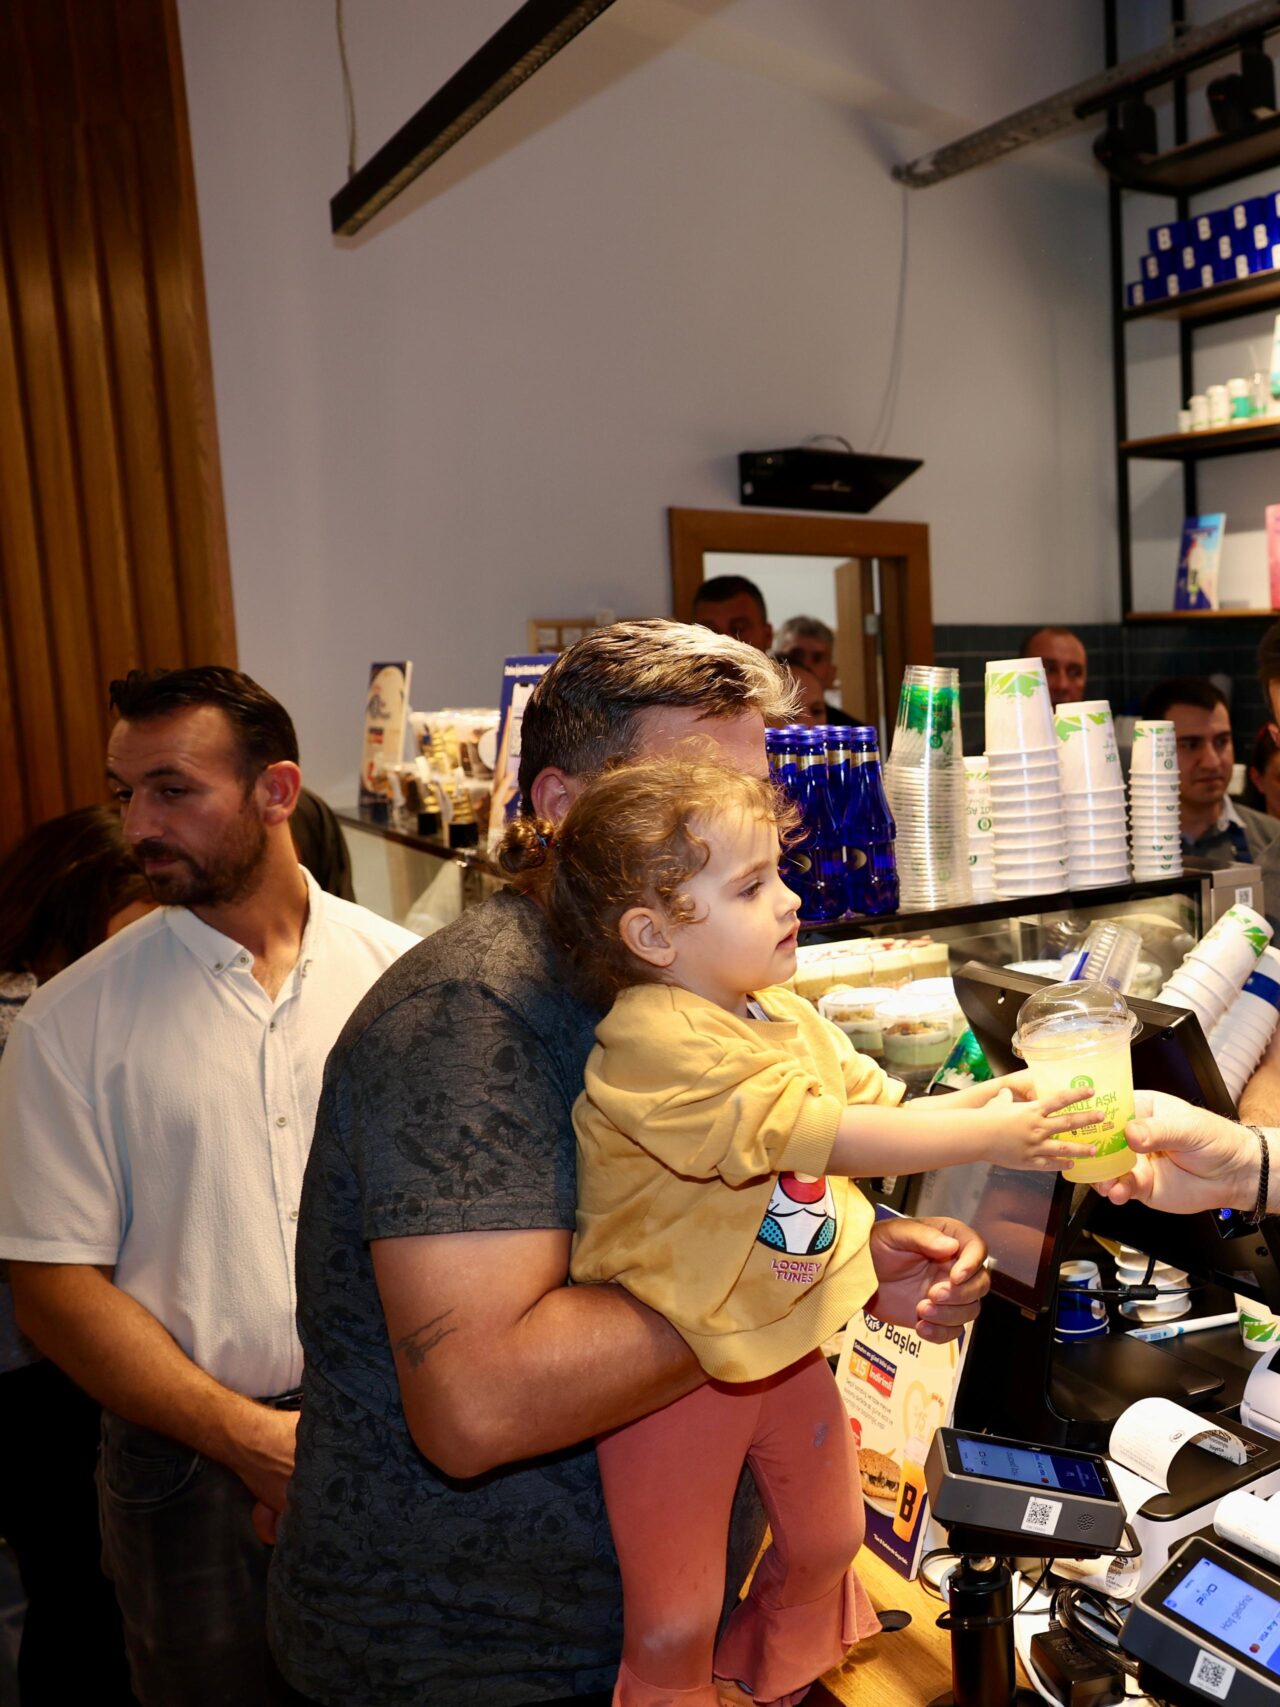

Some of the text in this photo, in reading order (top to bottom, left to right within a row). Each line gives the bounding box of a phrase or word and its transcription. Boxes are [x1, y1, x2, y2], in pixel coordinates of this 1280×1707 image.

[771, 1259, 822, 1272] LOONEY
[775, 1270, 814, 1283] TUNES
[884, 1323, 922, 1358] Başla!
[899, 1481, 917, 1521] B
